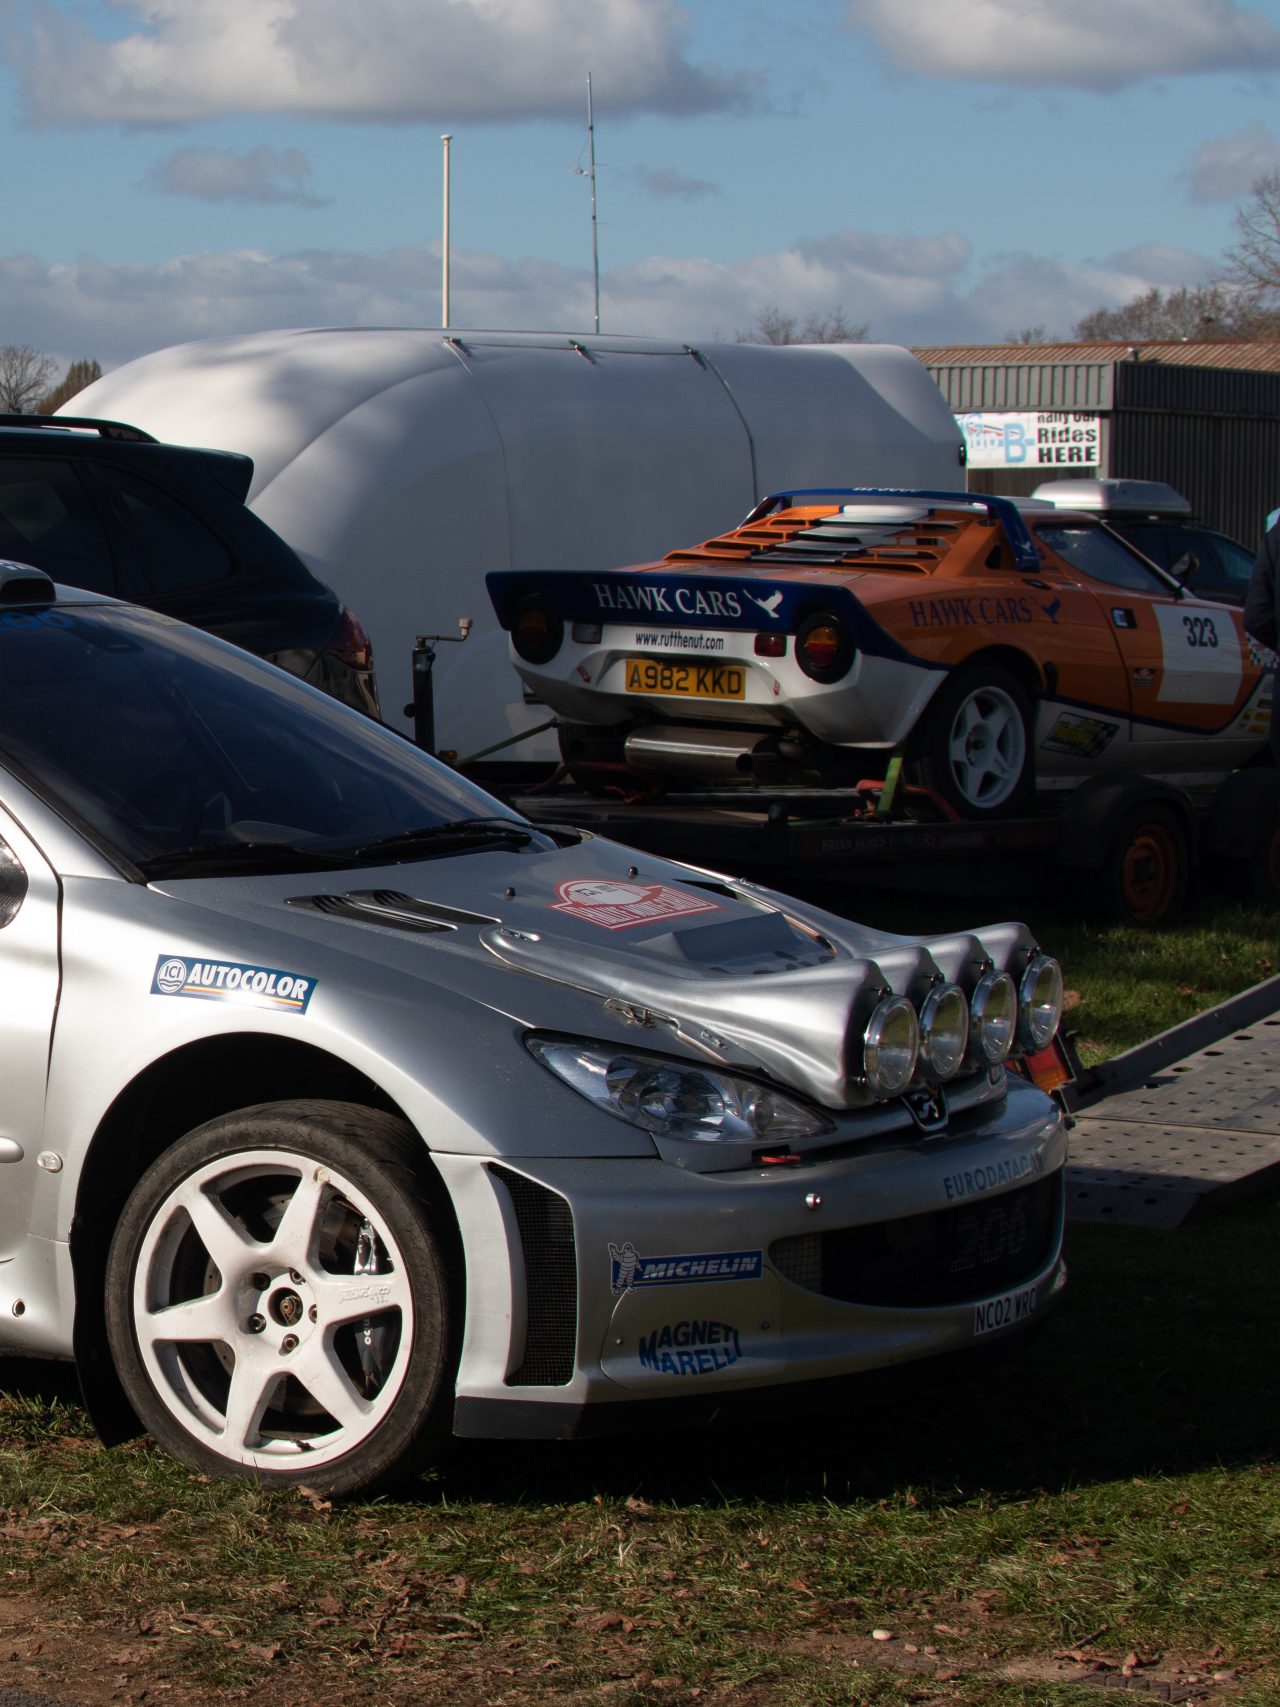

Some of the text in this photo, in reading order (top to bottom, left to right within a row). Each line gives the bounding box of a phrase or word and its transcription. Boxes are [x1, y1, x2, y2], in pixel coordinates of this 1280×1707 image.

[1037, 427, 1097, 443] Rides
[1038, 446, 1096, 463] HERE
[593, 583, 742, 618] HAWK CARS
[909, 598, 1033, 627] HAWK CARS
[635, 631, 724, 650] www.rutthenut.com
[1183, 615, 1218, 648] 323
[628, 665, 742, 695] A982 KKD
[163, 963, 309, 1000] ICI AUTOCOLOR
[642, 1256, 759, 1279] MICHELIN
[1014, 1287, 1037, 1320] WRC
[639, 1320, 741, 1350] MAGNETI
[639, 1347, 742, 1376] MARELLI
